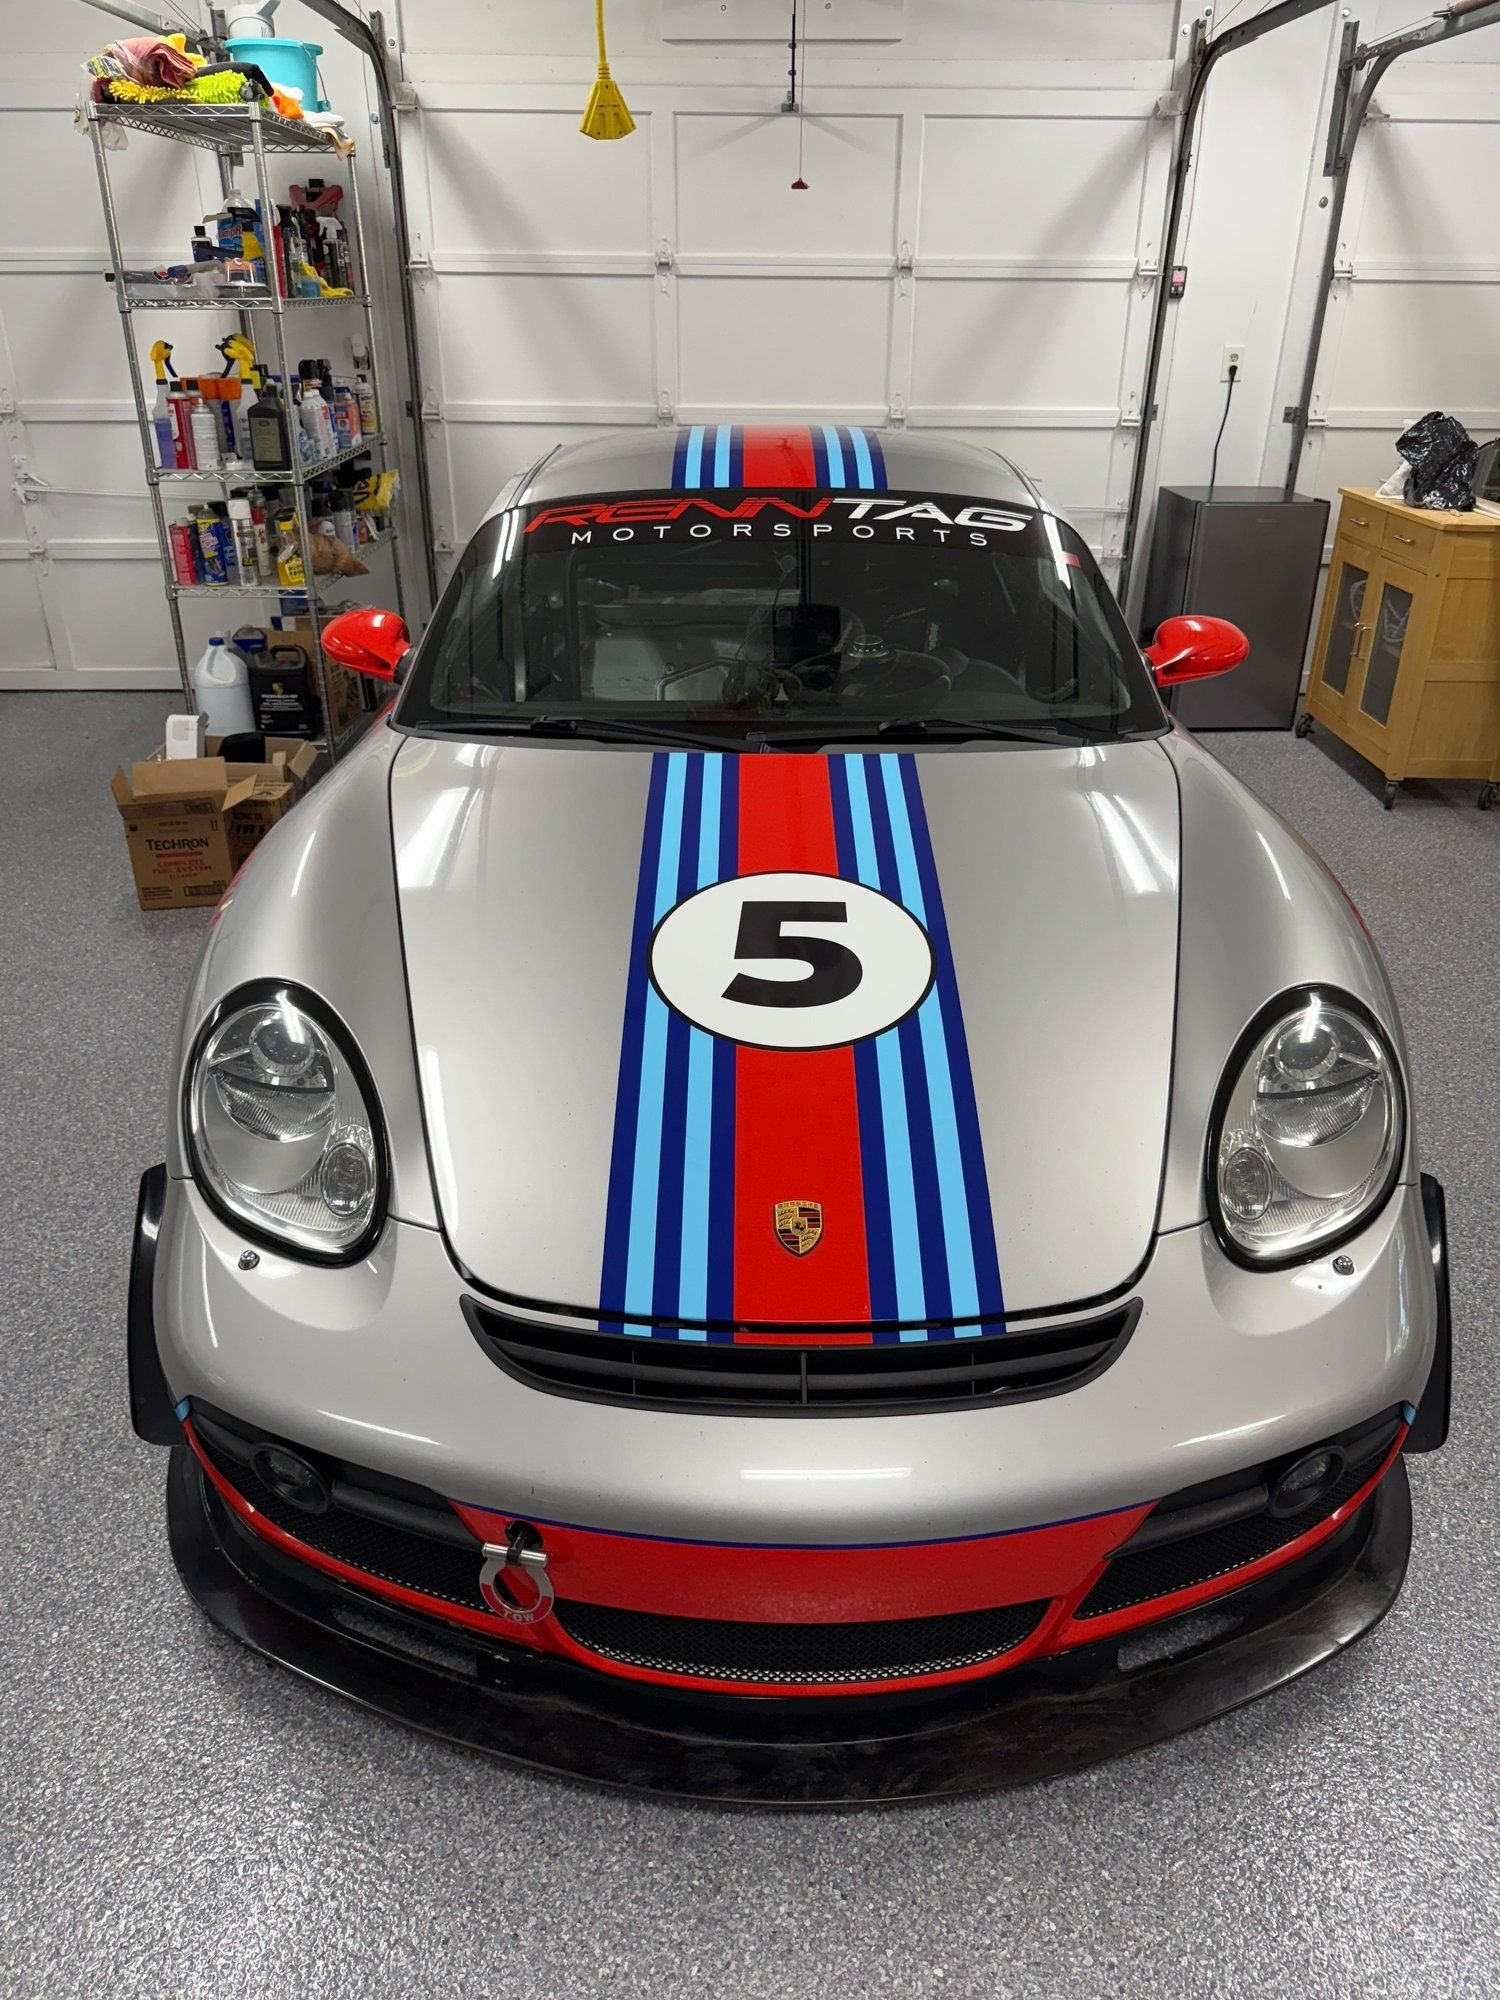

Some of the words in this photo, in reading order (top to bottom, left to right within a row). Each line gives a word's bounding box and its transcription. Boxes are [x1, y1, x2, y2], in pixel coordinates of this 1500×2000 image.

[524, 497, 1033, 533] RENNTAG
[571, 524, 987, 547] MOTORSPORTS
[145, 838, 209, 851] TECHRON
[721, 901, 863, 1008] 5
[503, 1609, 534, 1621] TOW
